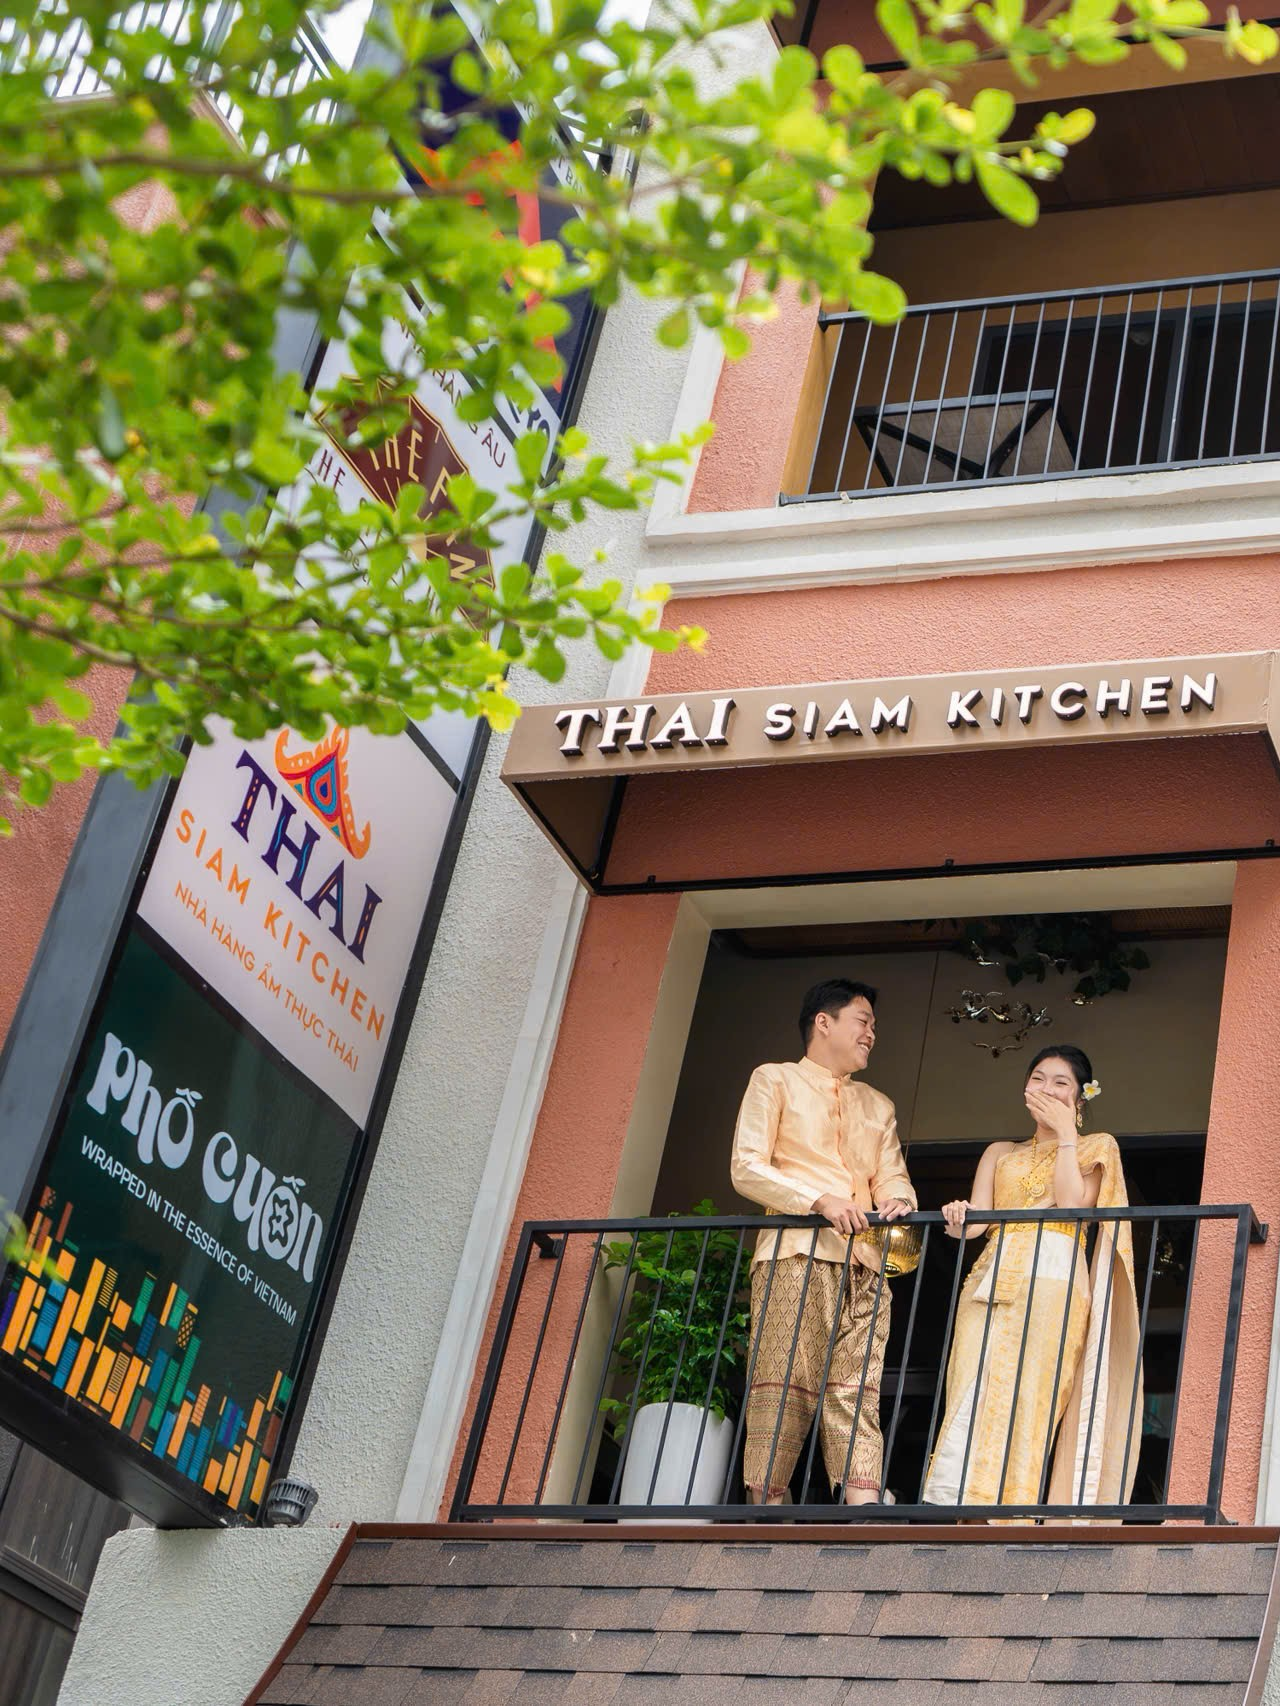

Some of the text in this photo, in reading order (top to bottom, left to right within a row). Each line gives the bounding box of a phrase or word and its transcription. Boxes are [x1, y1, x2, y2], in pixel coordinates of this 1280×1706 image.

[481, 427, 505, 468] ÂU
[554, 673, 1219, 756] THAI SIAM KITCHEN
[176, 809, 385, 1040] SIAM KITCHEN
[231, 749, 383, 965] THAI
[175, 880, 359, 1072] NHÀ HÀNG ẨM THỰC THÁI
[81, 1135, 298, 1327] WRAPPED IN THE ESSENCE OF VIETNAM
